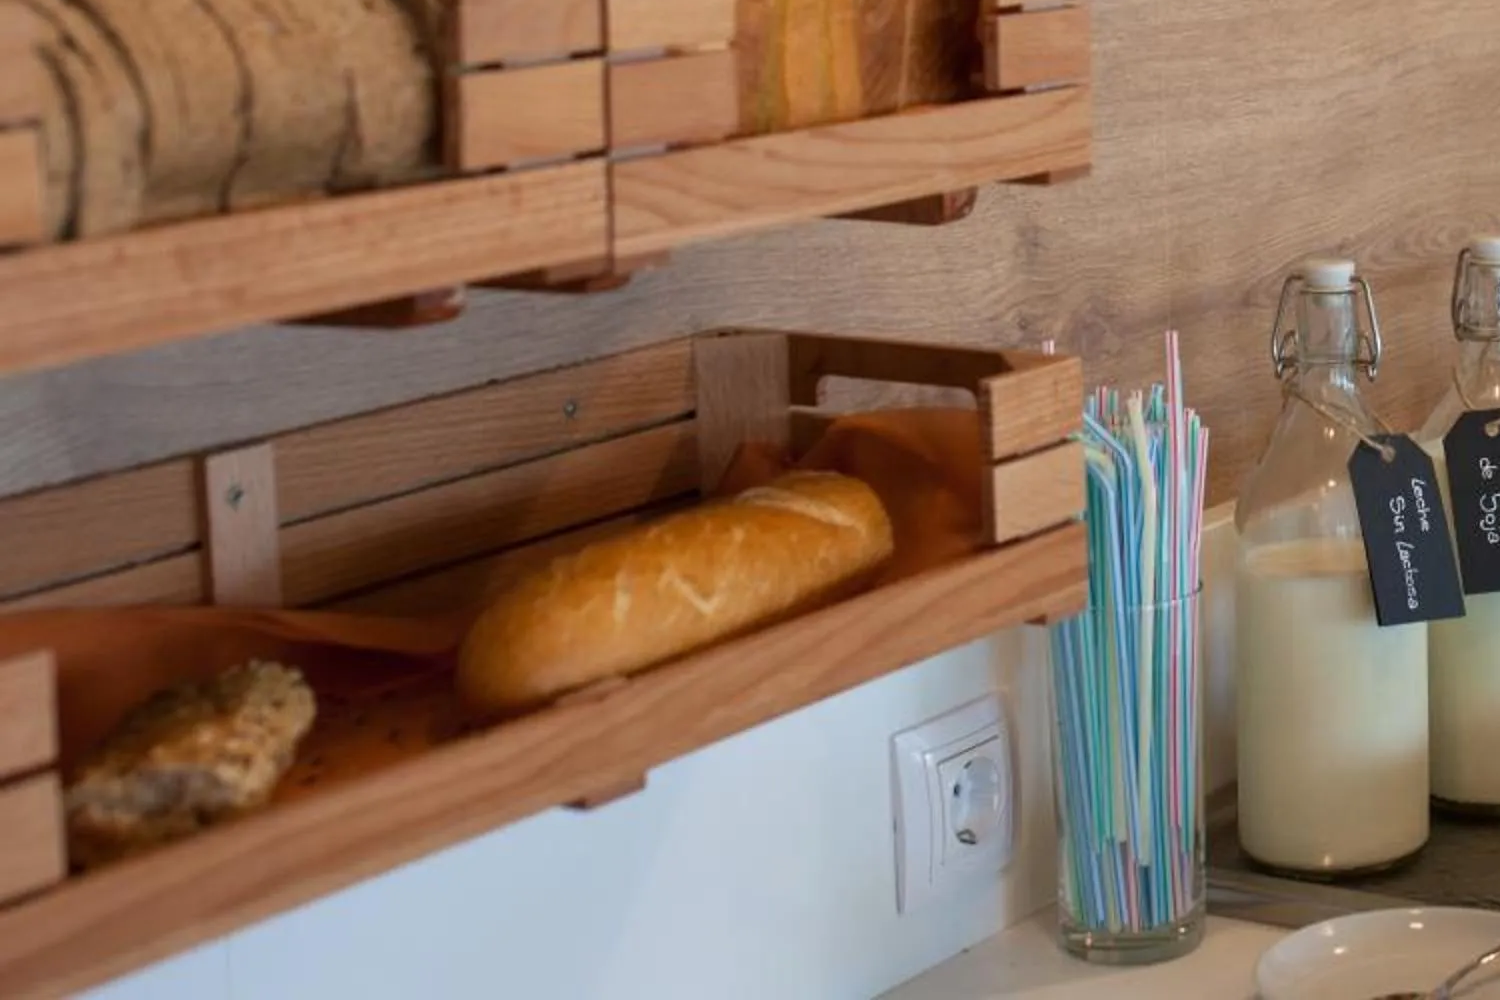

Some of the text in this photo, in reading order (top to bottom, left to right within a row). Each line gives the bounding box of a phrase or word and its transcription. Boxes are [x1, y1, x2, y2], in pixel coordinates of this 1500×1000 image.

[1479, 457, 1498, 480] de
[1411, 477, 1431, 532] Leche
[1389, 495, 1419, 610] Sin Lactosa
